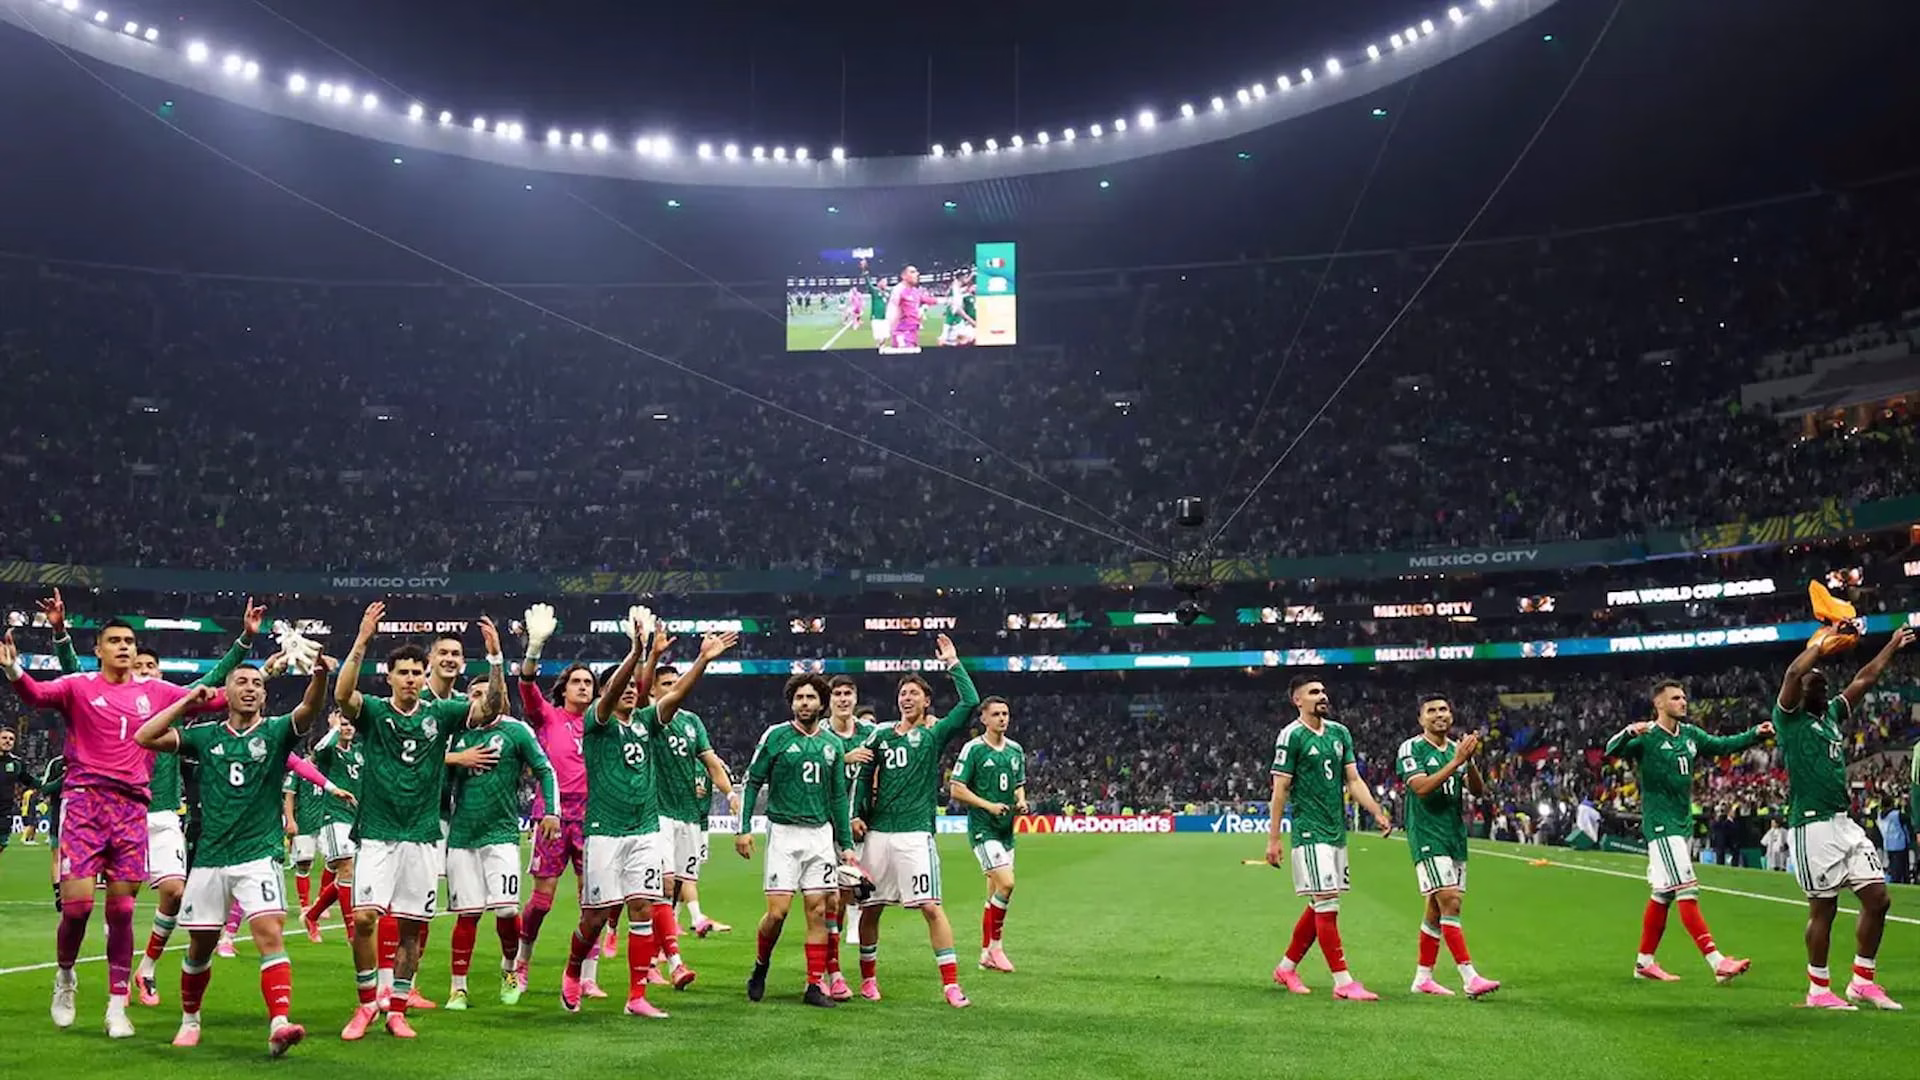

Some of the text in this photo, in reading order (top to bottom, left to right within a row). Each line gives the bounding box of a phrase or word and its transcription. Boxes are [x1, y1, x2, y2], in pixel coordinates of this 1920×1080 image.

[1409, 550, 1538, 567] MEXICO CITY
[332, 577, 450, 587] MEXICO CITY
[1692, 583, 1723, 599] CUP
[1373, 602, 1473, 618] MEXICO CITY
[377, 621, 468, 633] MEXICO CITY
[864, 617, 956, 630] MEXICO CITY
[1374, 645, 1475, 661] MEXICO CITY
[864, 659, 950, 672] MEXICO CIT
[119, 716, 128, 740] 1
[401, 739, 417, 762] 2
[623, 742, 645, 765] 23
[668, 735, 688, 757] 22
[884, 747, 908, 769] 20
[1677, 756, 1690, 776] 11
[228, 761, 246, 787] 6
[802, 761, 821, 784] 21
[1323, 759, 1334, 780] 5
[999, 773, 1009, 792] 8
[1054, 815, 1171, 832] McDonald's
[1226, 815, 1292, 832] Rexn
[260, 880, 275, 902] 6
[501, 874, 518, 895] 10
[911, 873, 929, 894] 20
[424, 890, 436, 913] 2
